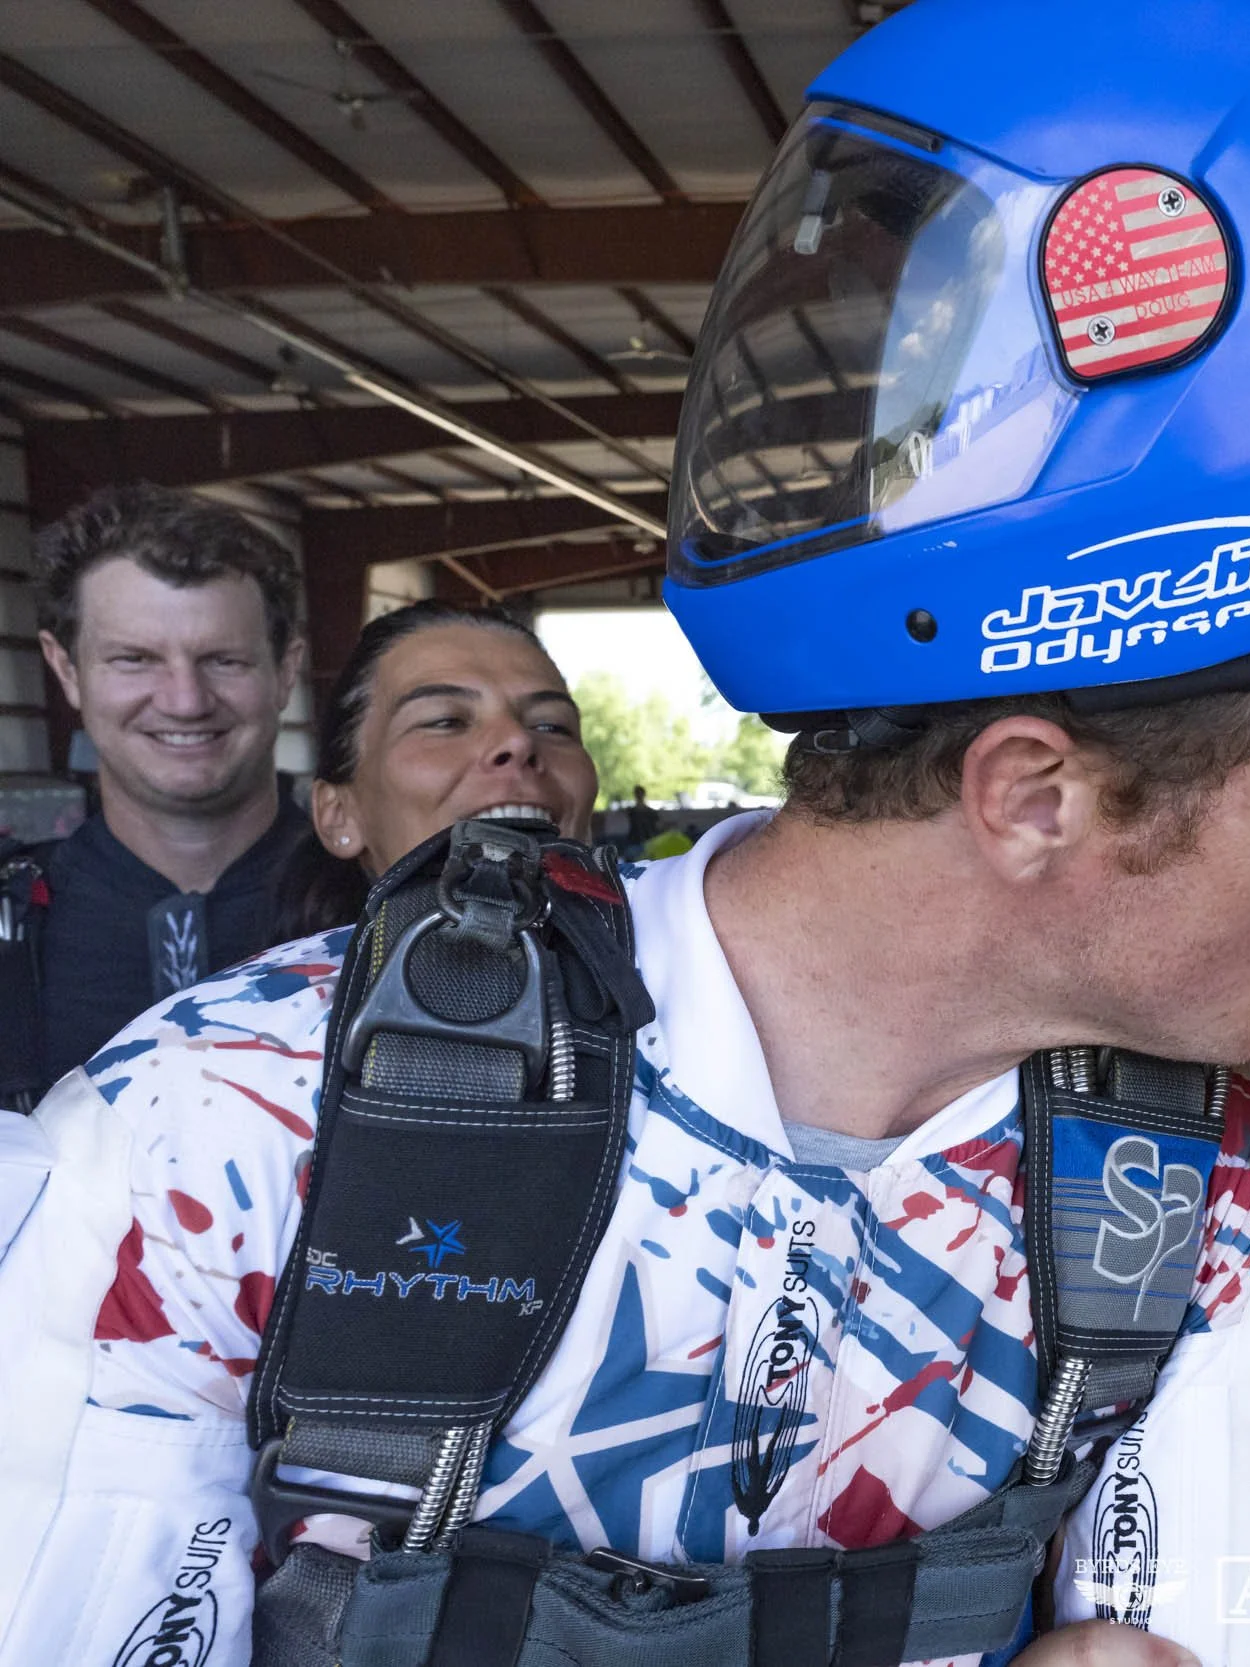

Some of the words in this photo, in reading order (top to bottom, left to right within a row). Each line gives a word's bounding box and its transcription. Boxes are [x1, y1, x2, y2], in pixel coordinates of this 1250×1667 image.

[1060, 286, 1101, 308] USA
[1119, 270, 1157, 292] WAY
[1168, 255, 1217, 281] TEAM
[1136, 293, 1191, 319] DOUG
[305, 1265, 536, 1303] RHYTHM
[783, 1220, 816, 1293] SUITS
[766, 1294, 806, 1388] TONY
[1113, 1472, 1140, 1555] TONY
[143, 1592, 203, 1667] ONY
[175, 1517, 232, 1590] SUITS
